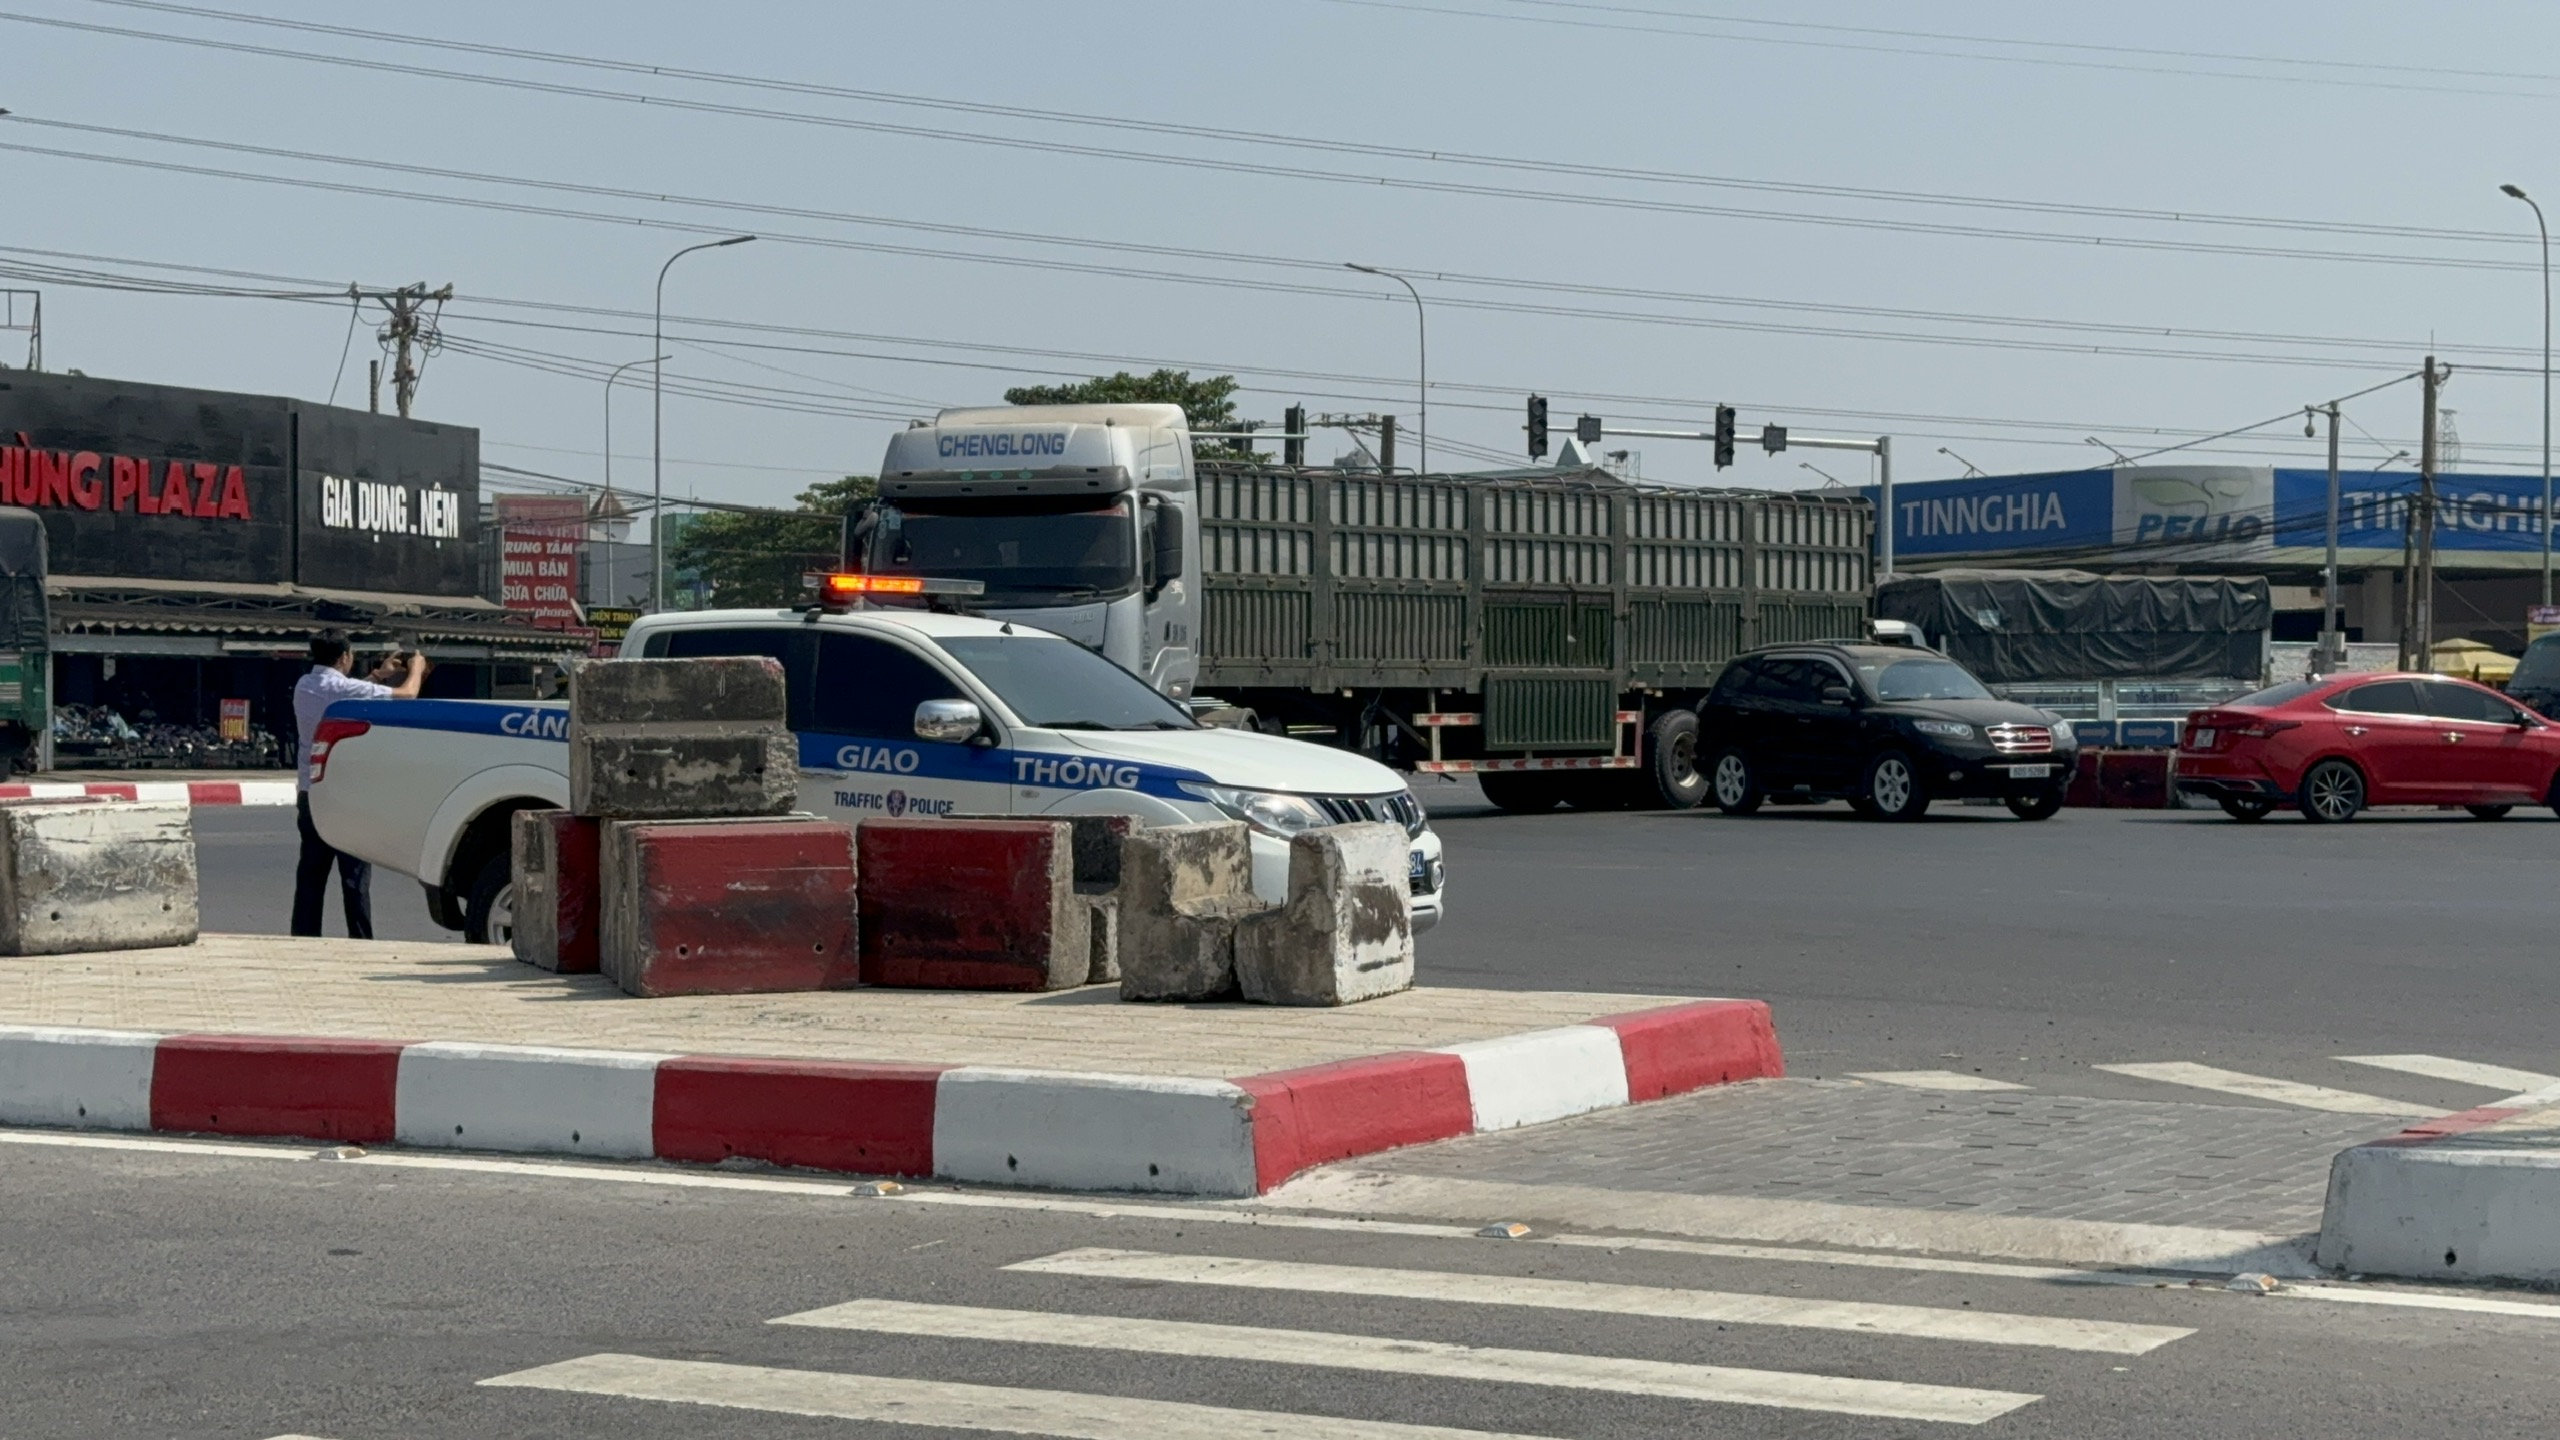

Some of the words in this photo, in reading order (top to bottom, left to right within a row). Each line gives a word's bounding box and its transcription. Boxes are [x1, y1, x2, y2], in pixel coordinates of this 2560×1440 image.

[939, 433, 1066, 457] CHENGLONG
[112, 455, 251, 520] PLAZA
[323, 476, 353, 529] GIA
[358, 482, 407, 543] DỤNG
[420, 482, 459, 548] NỆM
[1902, 492, 2066, 536] TINNGHIA
[2343, 491, 2560, 533] TINNGHI
[503, 542, 542, 554] RUNG
[546, 540, 573, 554] TÂM
[503, 561, 534, 577] MUA
[538, 558, 568, 577] BÁN
[503, 580, 530, 600] SỬA
[534, 583, 568, 601] CHỮA
[836, 744, 920, 773] GIAO
[1013, 756, 1141, 789] THÔNG
[833, 790, 883, 810] TRAFFIC
[908, 797, 954, 815] POLICE
